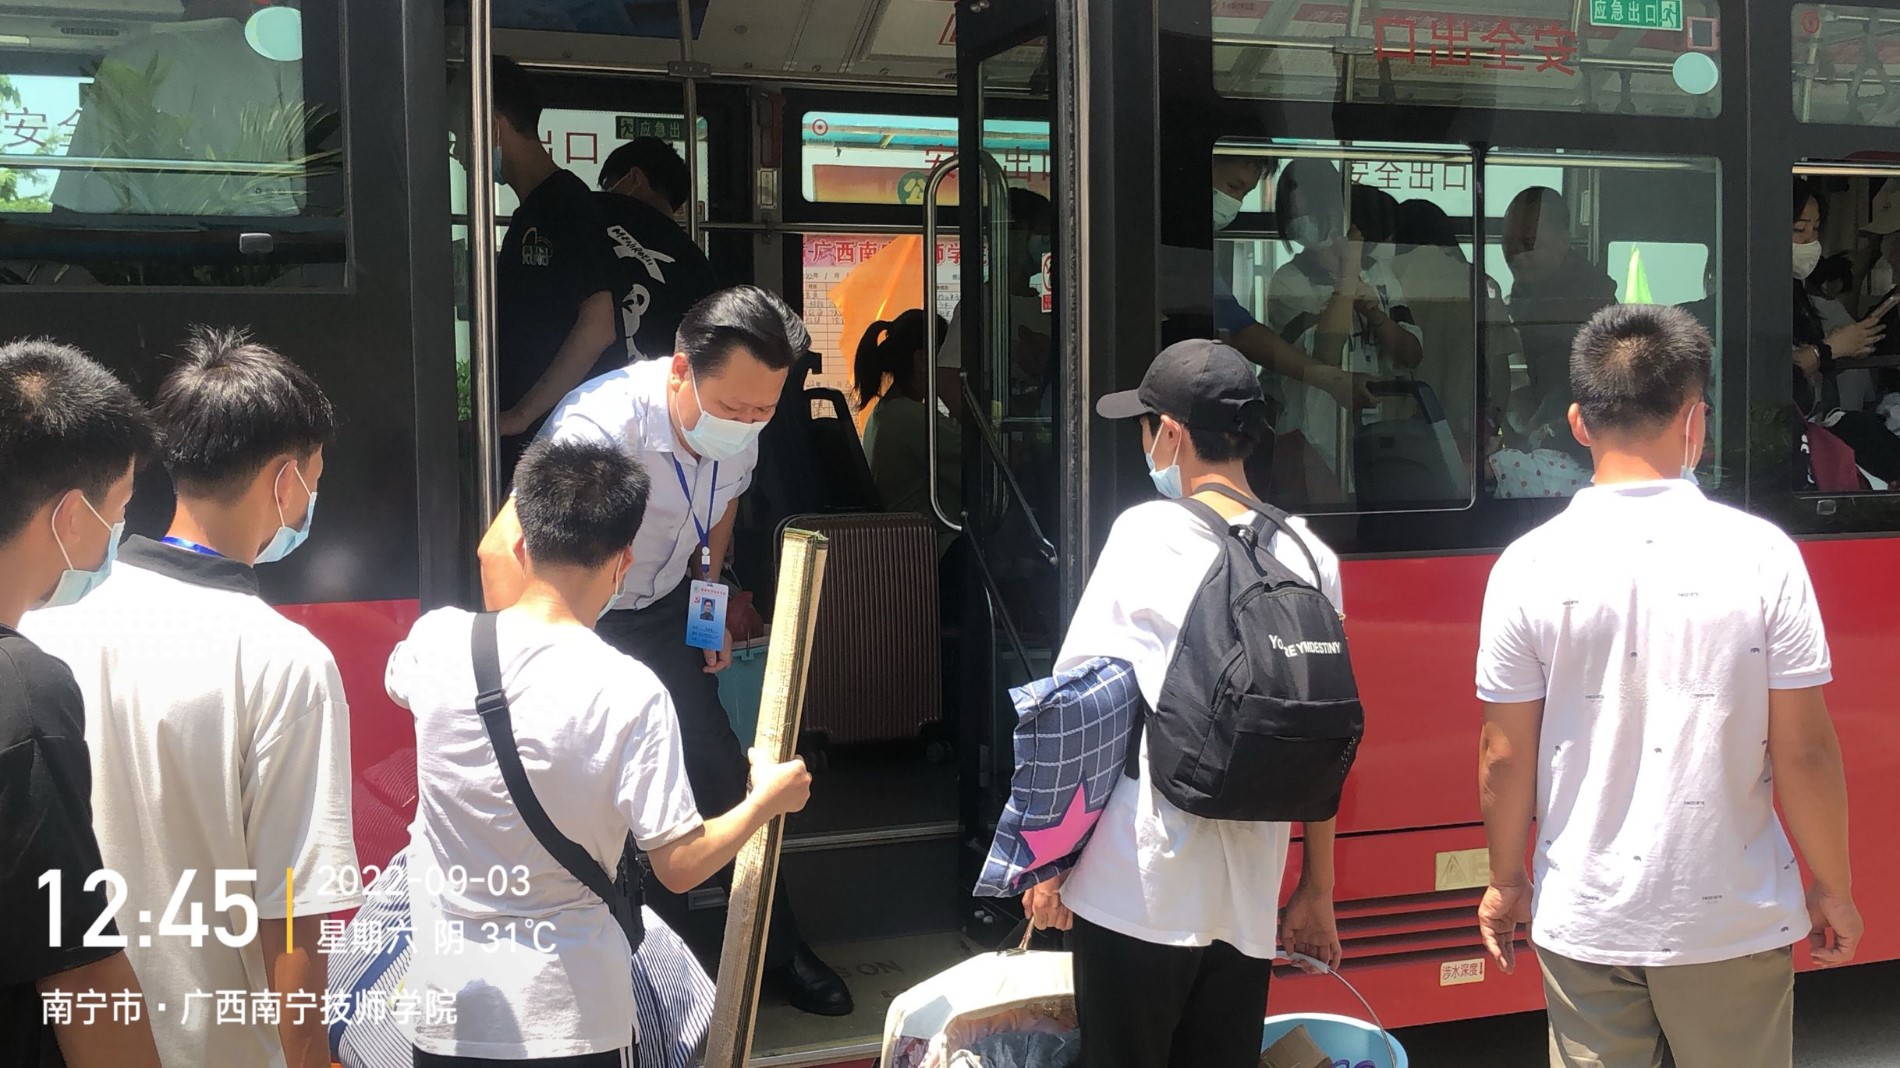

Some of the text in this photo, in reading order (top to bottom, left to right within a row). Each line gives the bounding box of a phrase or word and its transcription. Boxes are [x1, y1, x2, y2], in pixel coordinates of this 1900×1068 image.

[1594, 0, 1657, 23] 应急出口
[1442, 962, 1478, 980] 涉水深度
